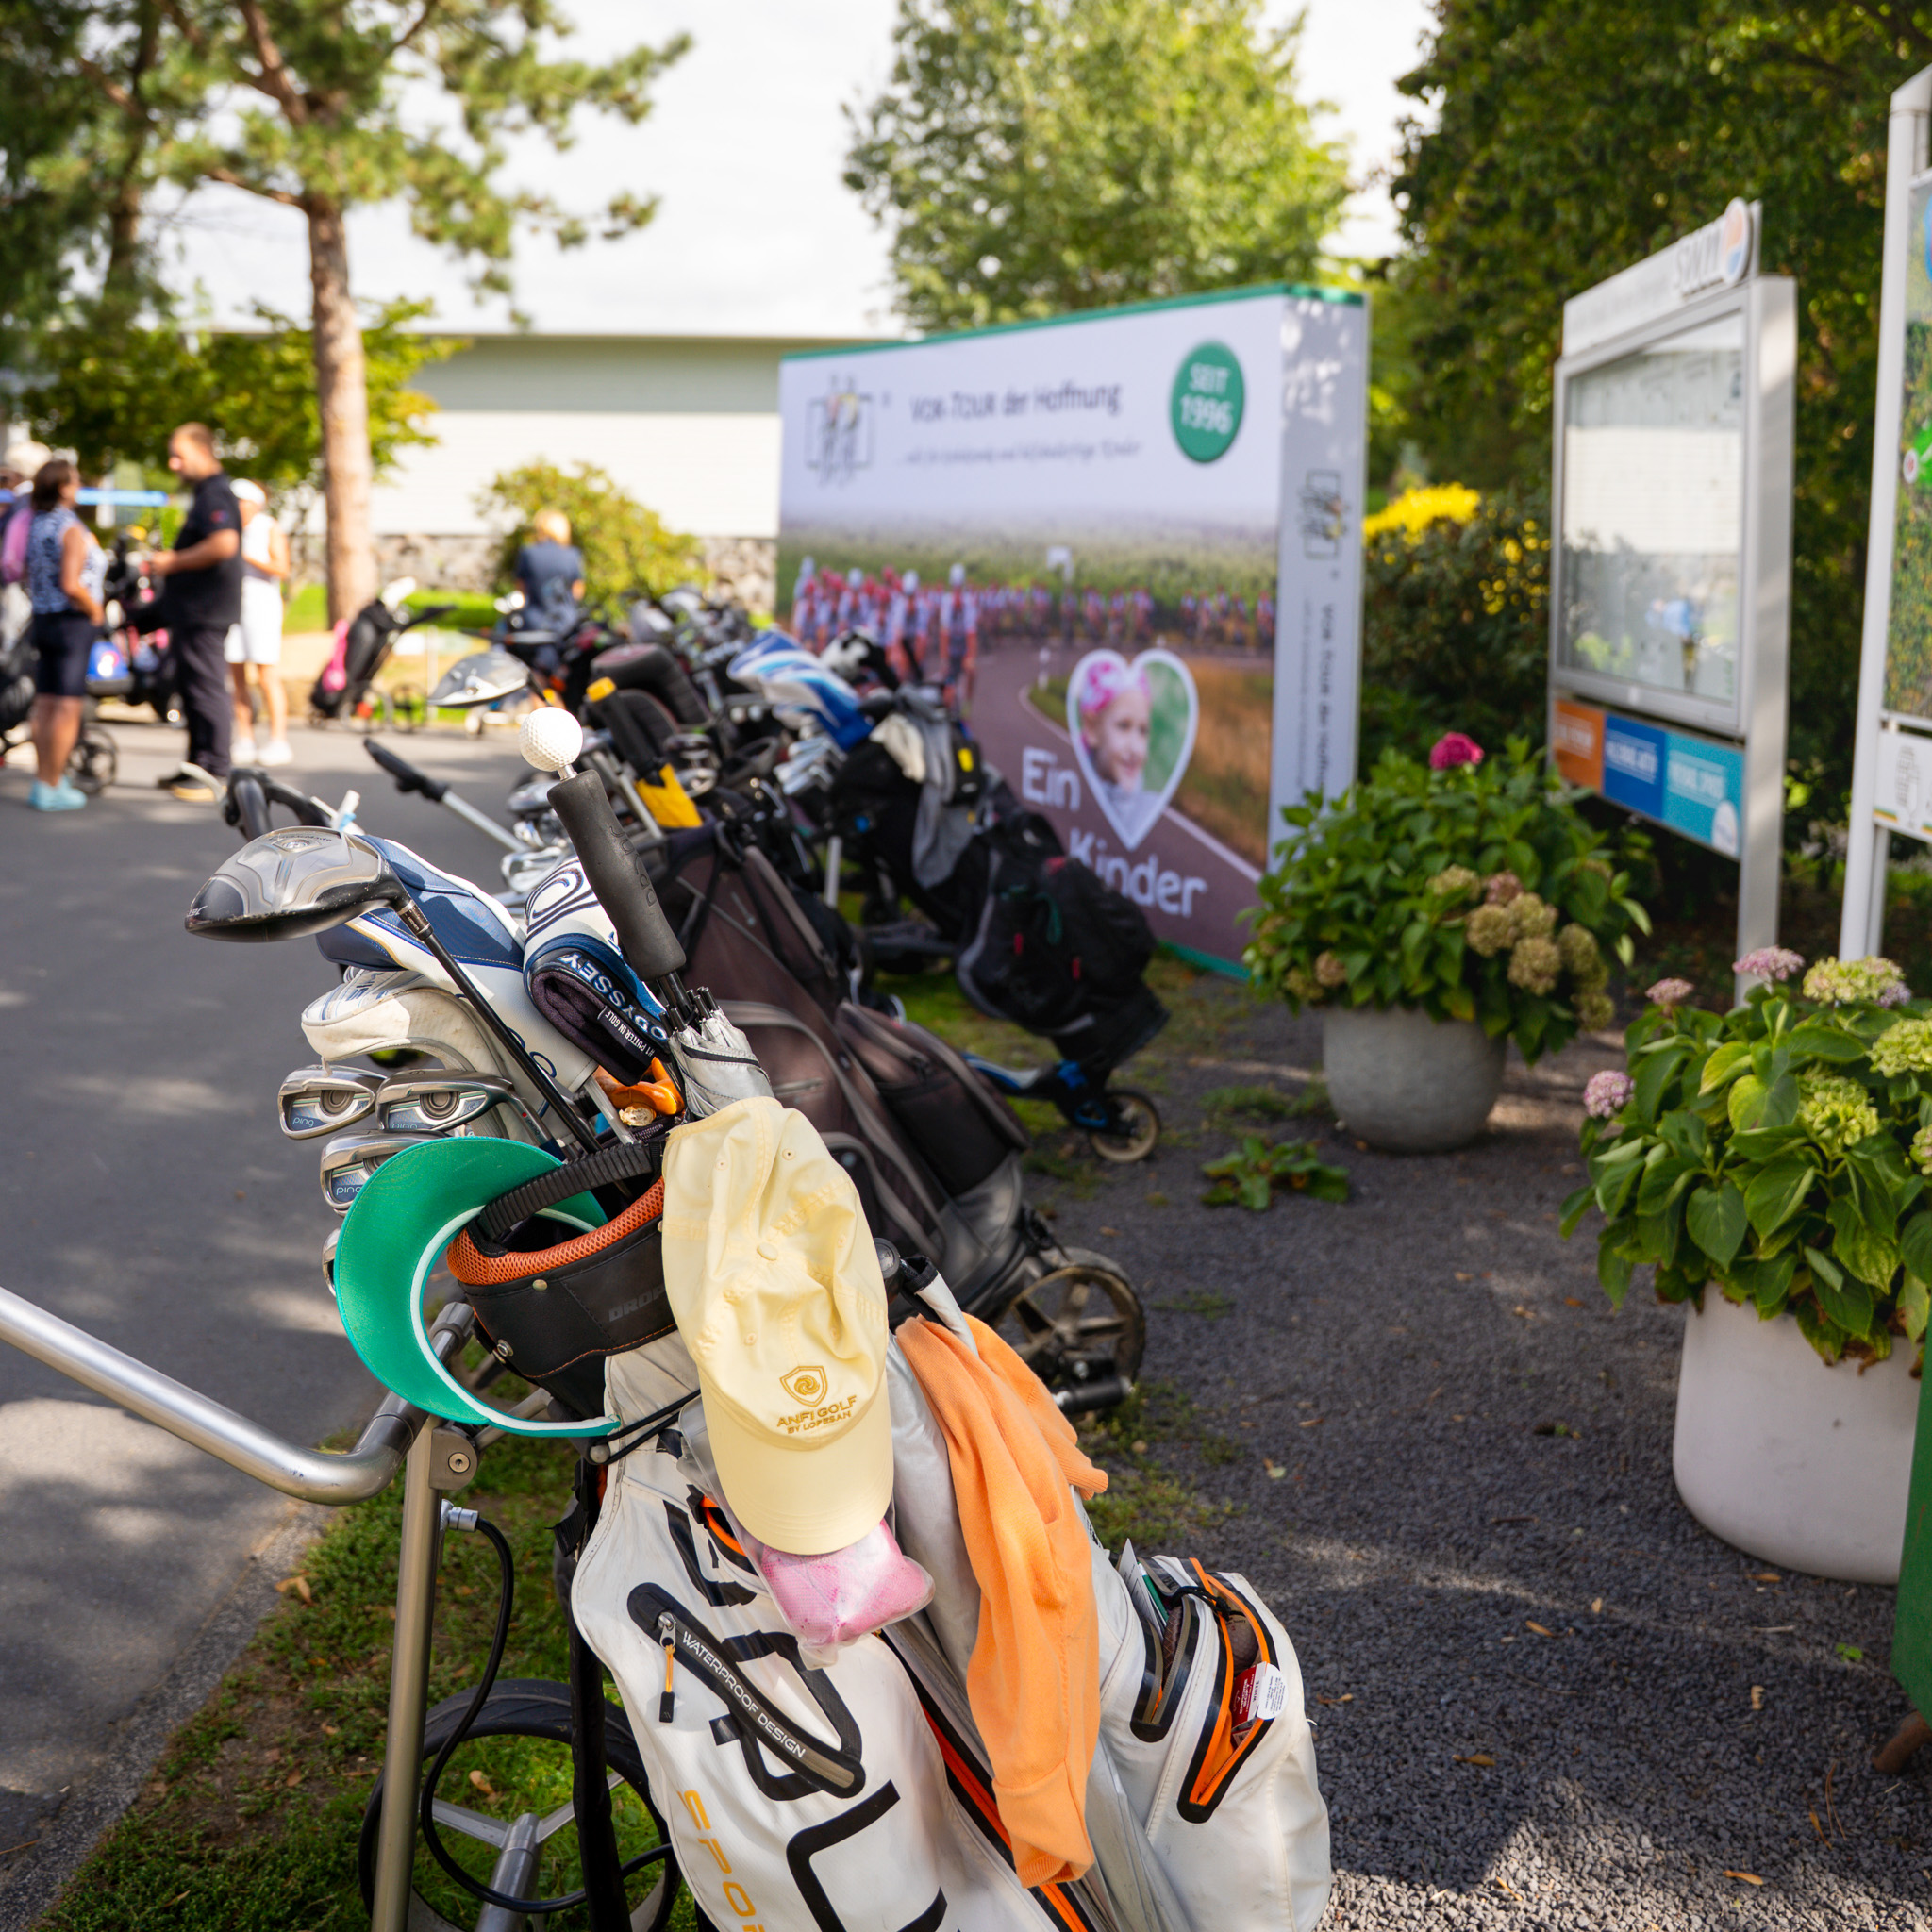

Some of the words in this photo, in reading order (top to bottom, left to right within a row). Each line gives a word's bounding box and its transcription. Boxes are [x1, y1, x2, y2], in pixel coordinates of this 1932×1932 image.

[1189, 363, 1228, 393] SEIT
[1034, 380, 1122, 416] Hoffnung
[1181, 394, 1233, 435] 1996
[1023, 746, 1081, 810] Ein
[1069, 827, 1209, 919] Kinder
[557, 953, 668, 1041] ODYSSEY
[605, 1009, 621, 1027] GOLF
[625, 1031, 650, 1052] PUTTER
[292, 1116, 315, 1127] ping
[776, 1410, 815, 1427] ANFI
[817, 1394, 857, 1418] GOLF
[787, 1424, 801, 1434] BY
[803, 1410, 852, 1431] LOPESAN
[682, 1630, 759, 1713] WATERPROOF
[757, 1712, 807, 1757] DESIGN
[676, 1789, 766, 1932] SPO
